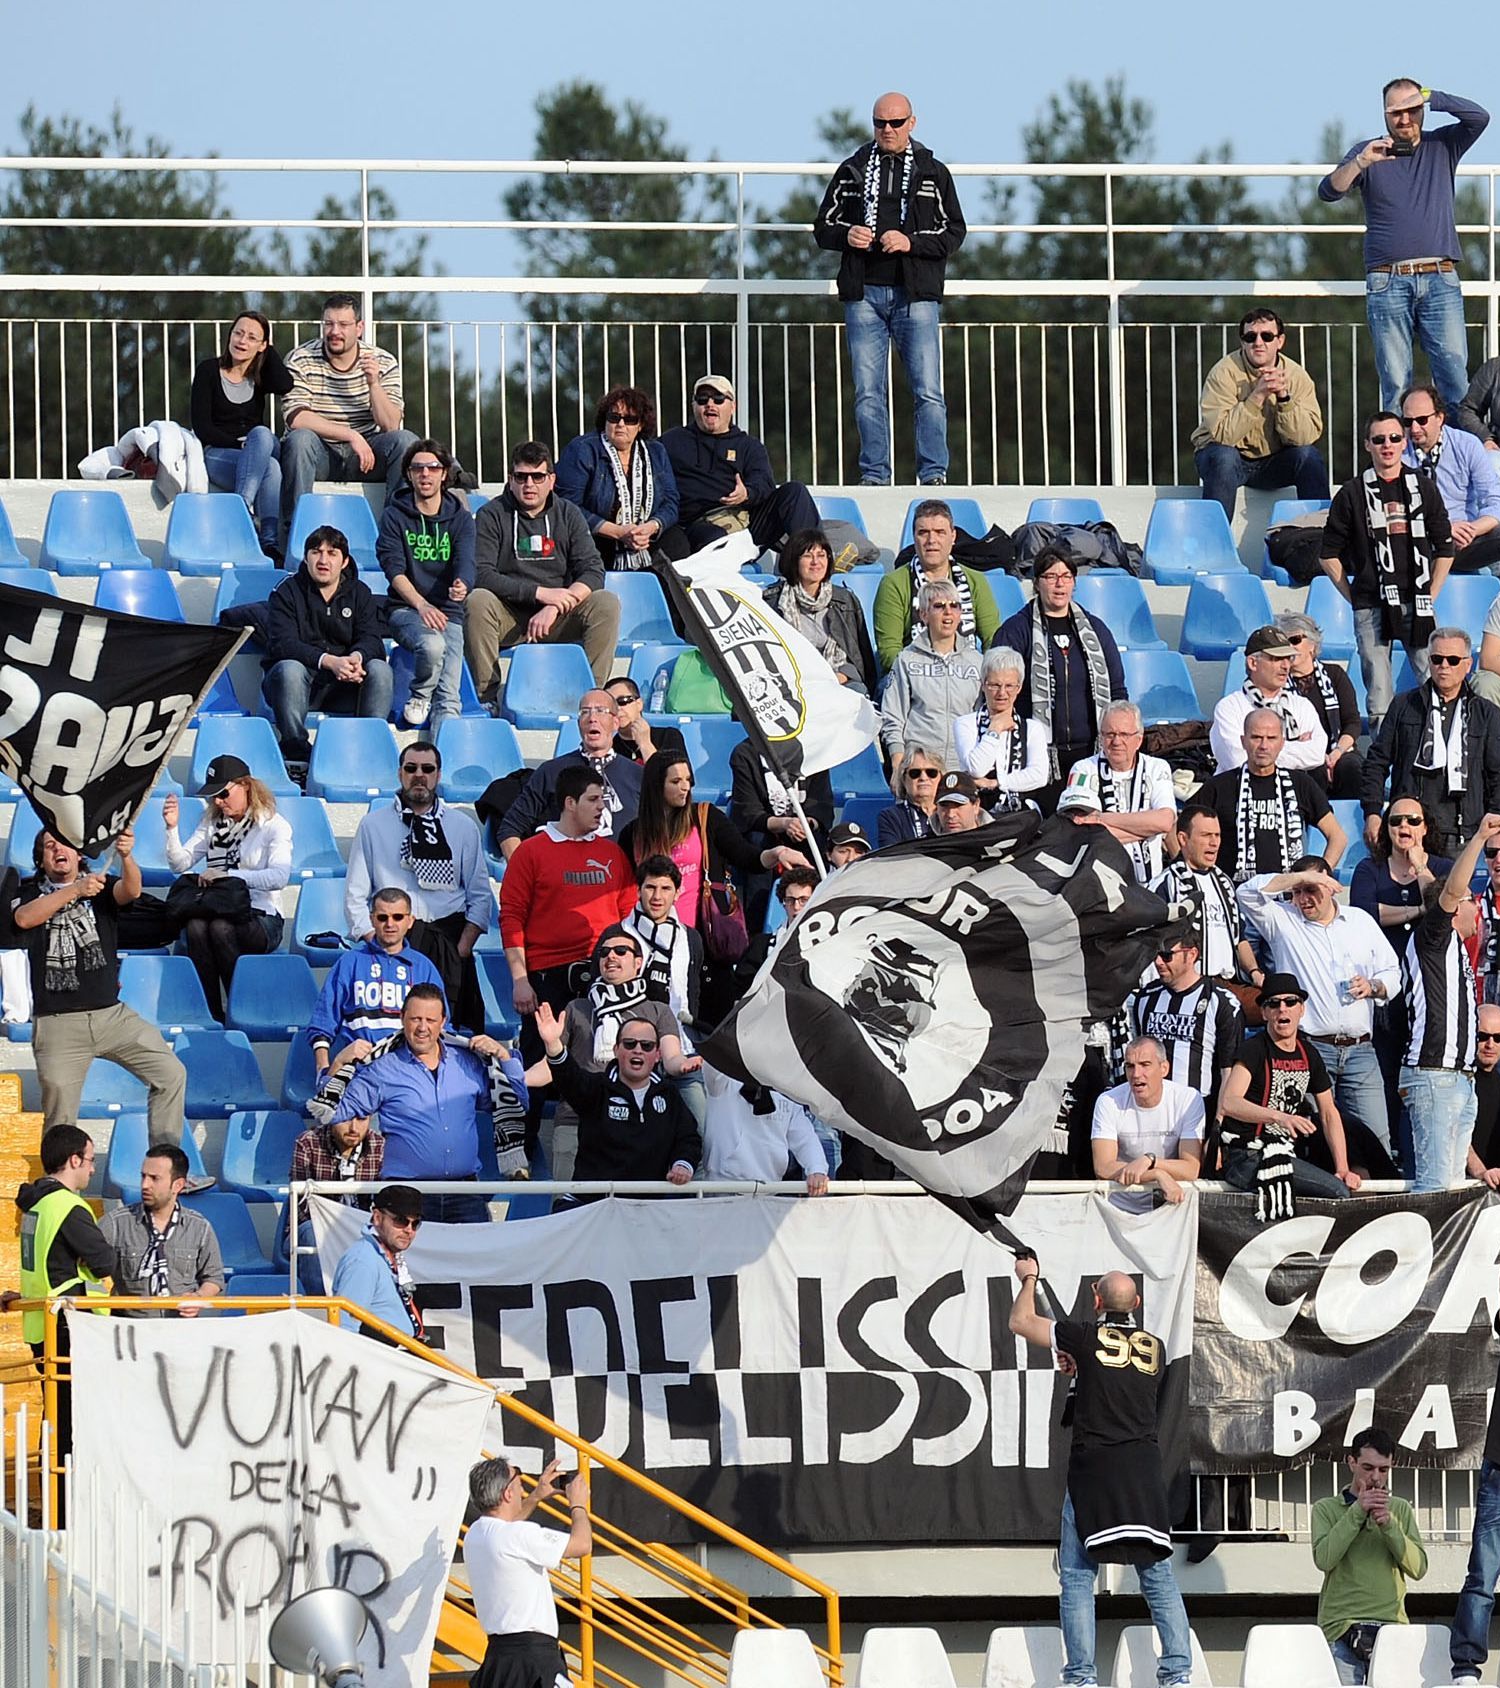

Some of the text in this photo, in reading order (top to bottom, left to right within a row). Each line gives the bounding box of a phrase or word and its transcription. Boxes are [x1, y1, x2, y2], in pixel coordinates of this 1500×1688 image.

[906, 661, 982, 682] SIENA
[752, 697, 780, 716] Robur
[759, 706, 787, 724] 1904
[563, 871, 606, 886] PUMA
[354, 979, 412, 1010] ROBU
[1148, 1012, 1198, 1026] MONTE
[1146, 1023, 1197, 1037] PASCHI
[1095, 1326, 1160, 1377] 99
